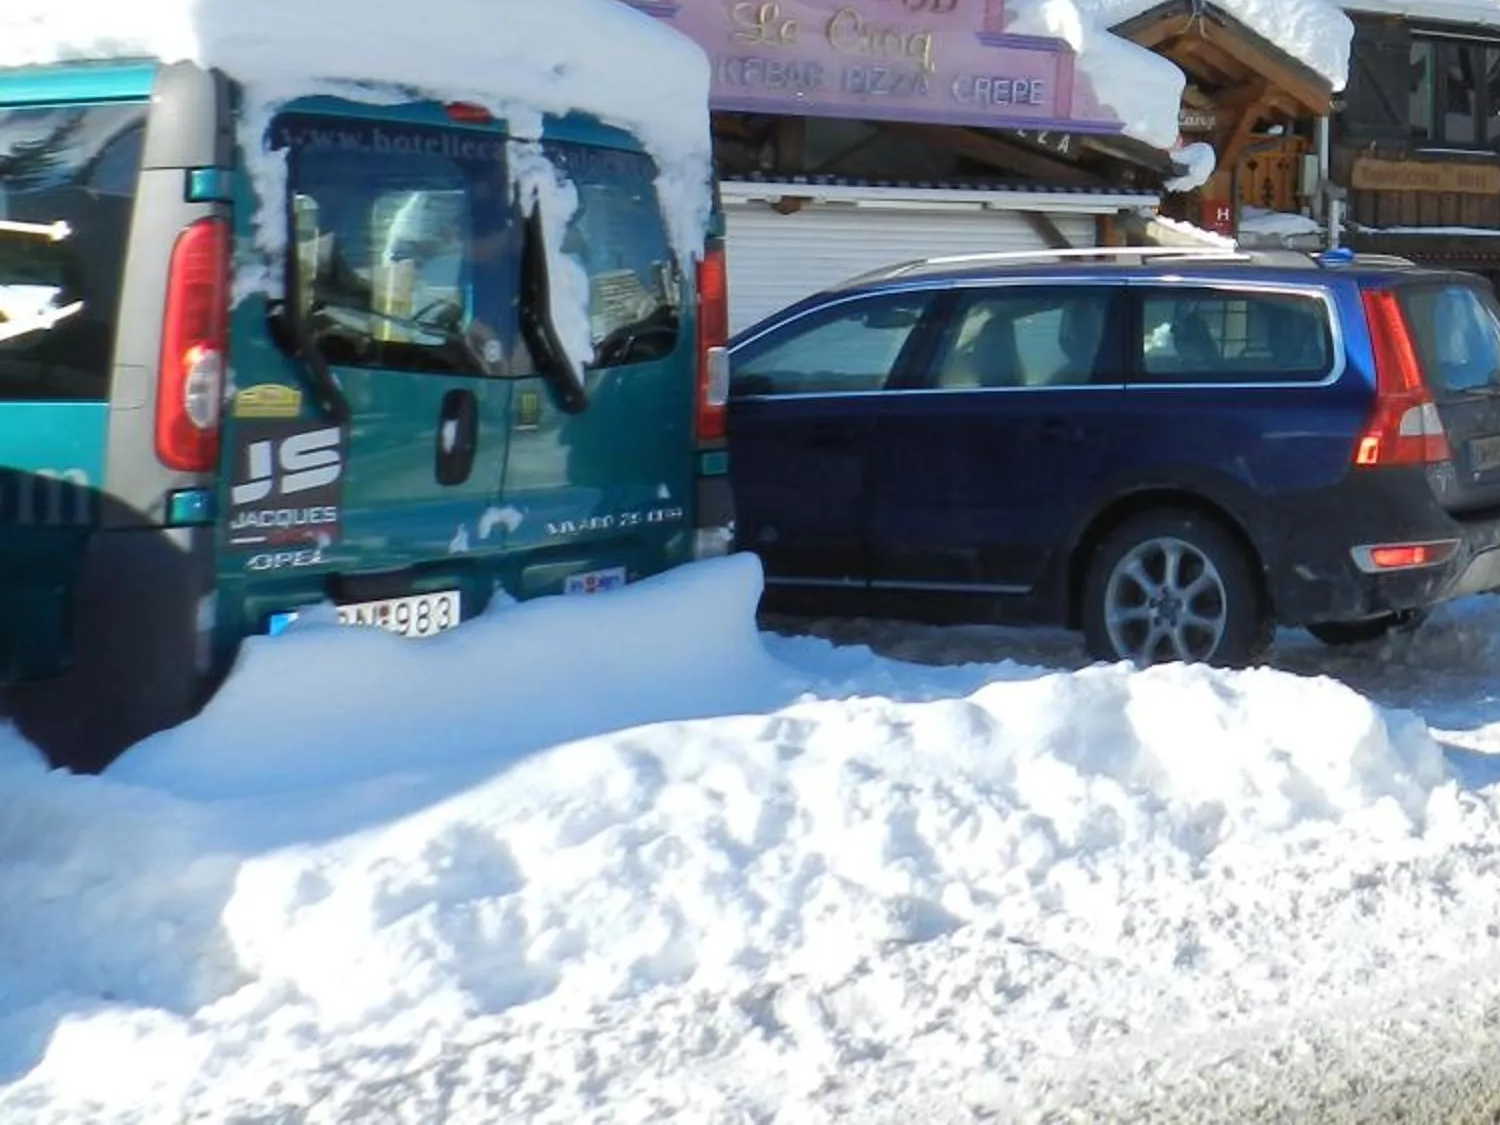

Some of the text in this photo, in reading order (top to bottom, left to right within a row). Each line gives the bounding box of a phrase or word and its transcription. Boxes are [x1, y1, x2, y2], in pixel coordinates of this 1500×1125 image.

[729, 1, 936, 74] Le Croq
[952, 74, 1047, 109] CREPE
[1216, 207, 1230, 221] H
[231, 426, 342, 506] JS
[230, 505, 338, 530] JACQUES
[246, 546, 328, 571] OPEL
[395, 596, 451, 636] 983
